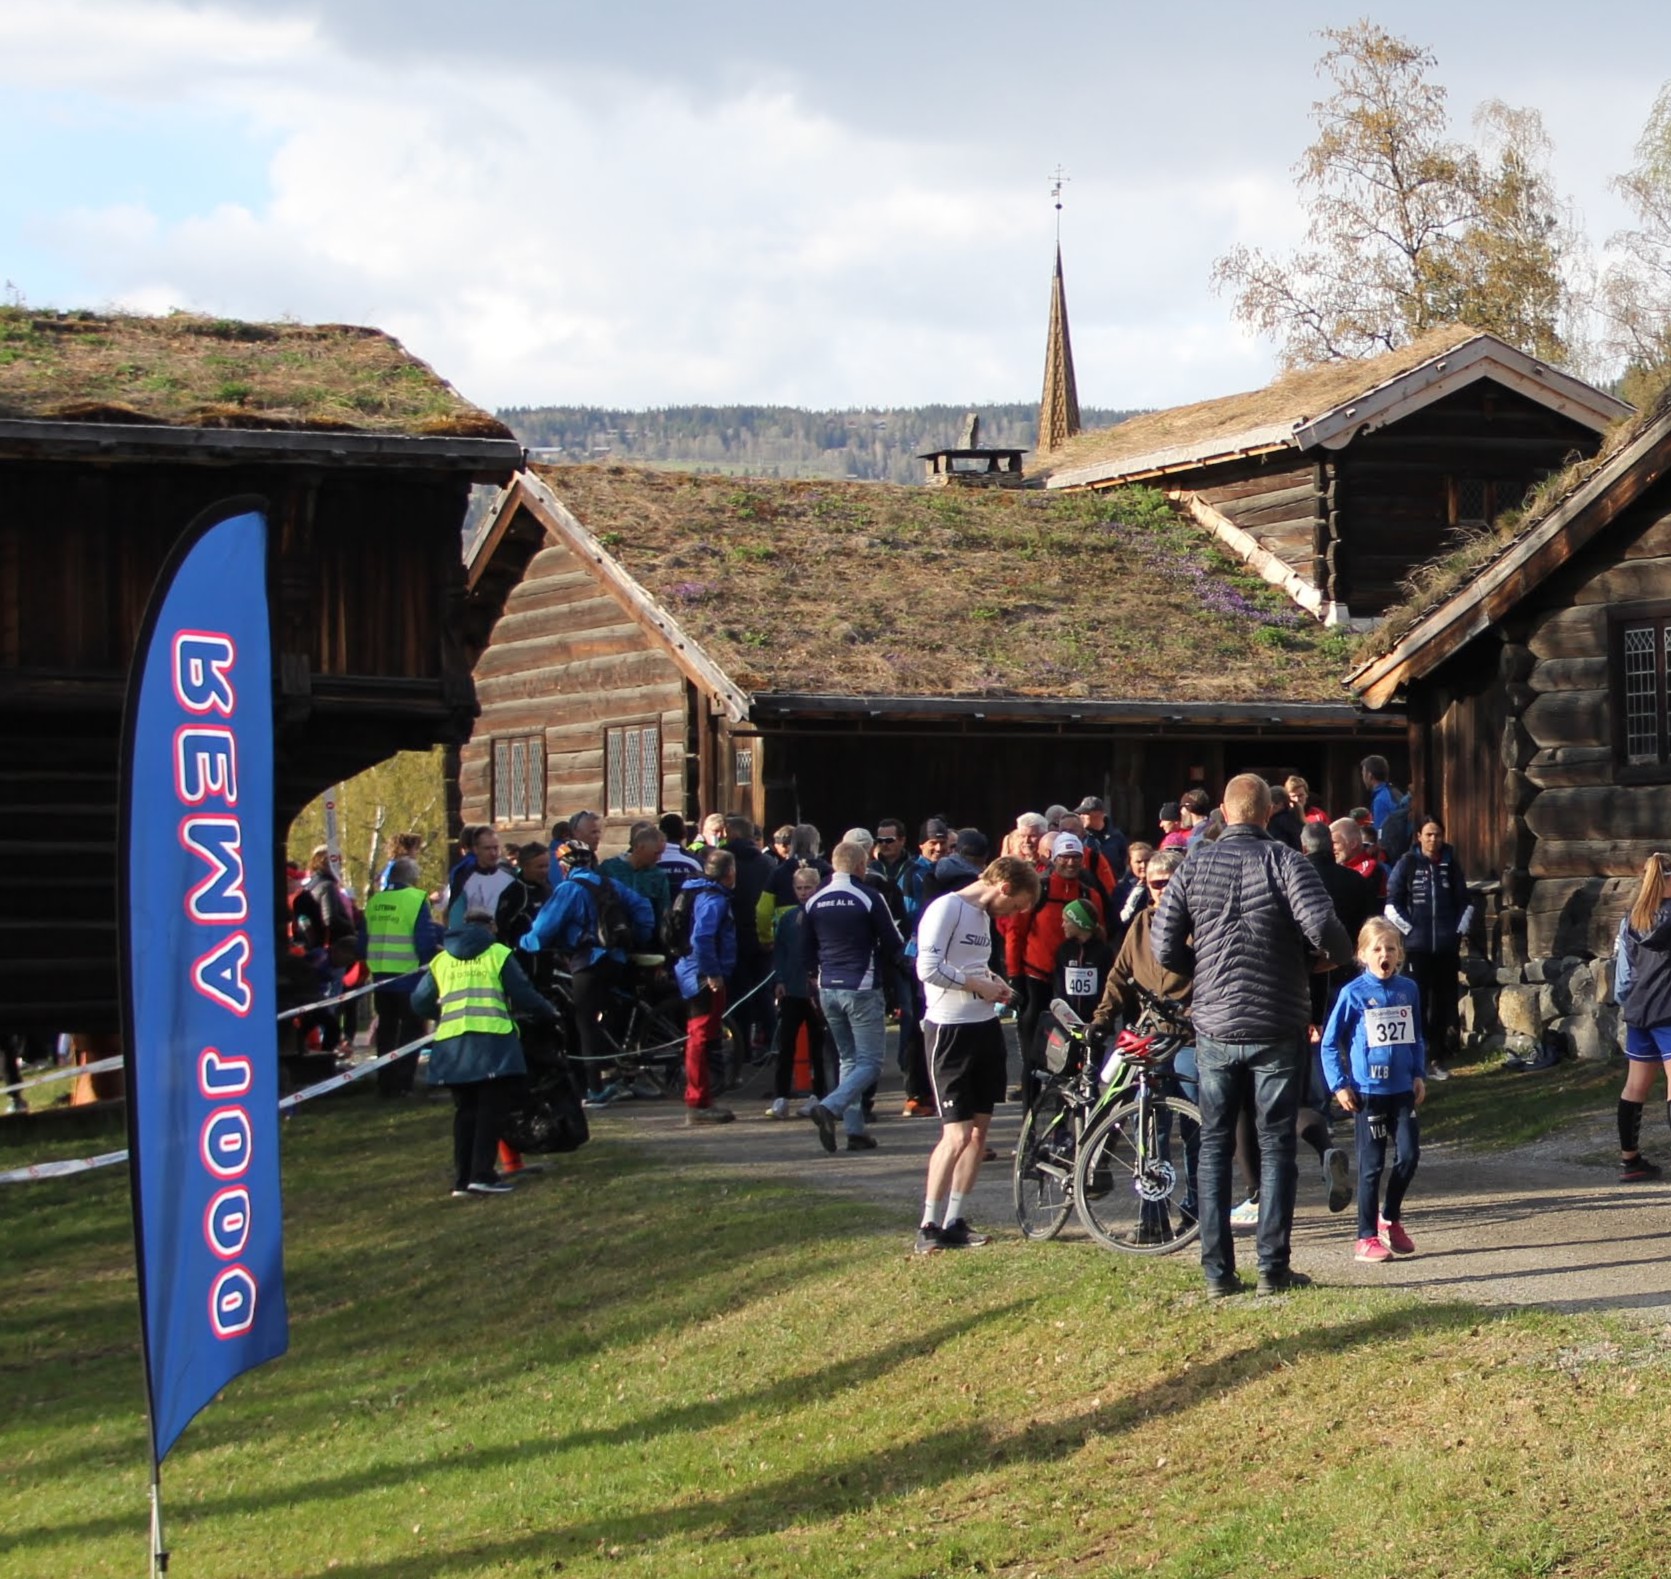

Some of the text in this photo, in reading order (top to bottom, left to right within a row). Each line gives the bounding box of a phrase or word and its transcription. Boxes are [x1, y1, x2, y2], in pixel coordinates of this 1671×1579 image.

[1069, 979, 1091, 993] 405
[1376, 1021, 1407, 1043] 327
[1370, 1065, 1390, 1079] VLB
[1369, 1124, 1388, 1140] VLB
